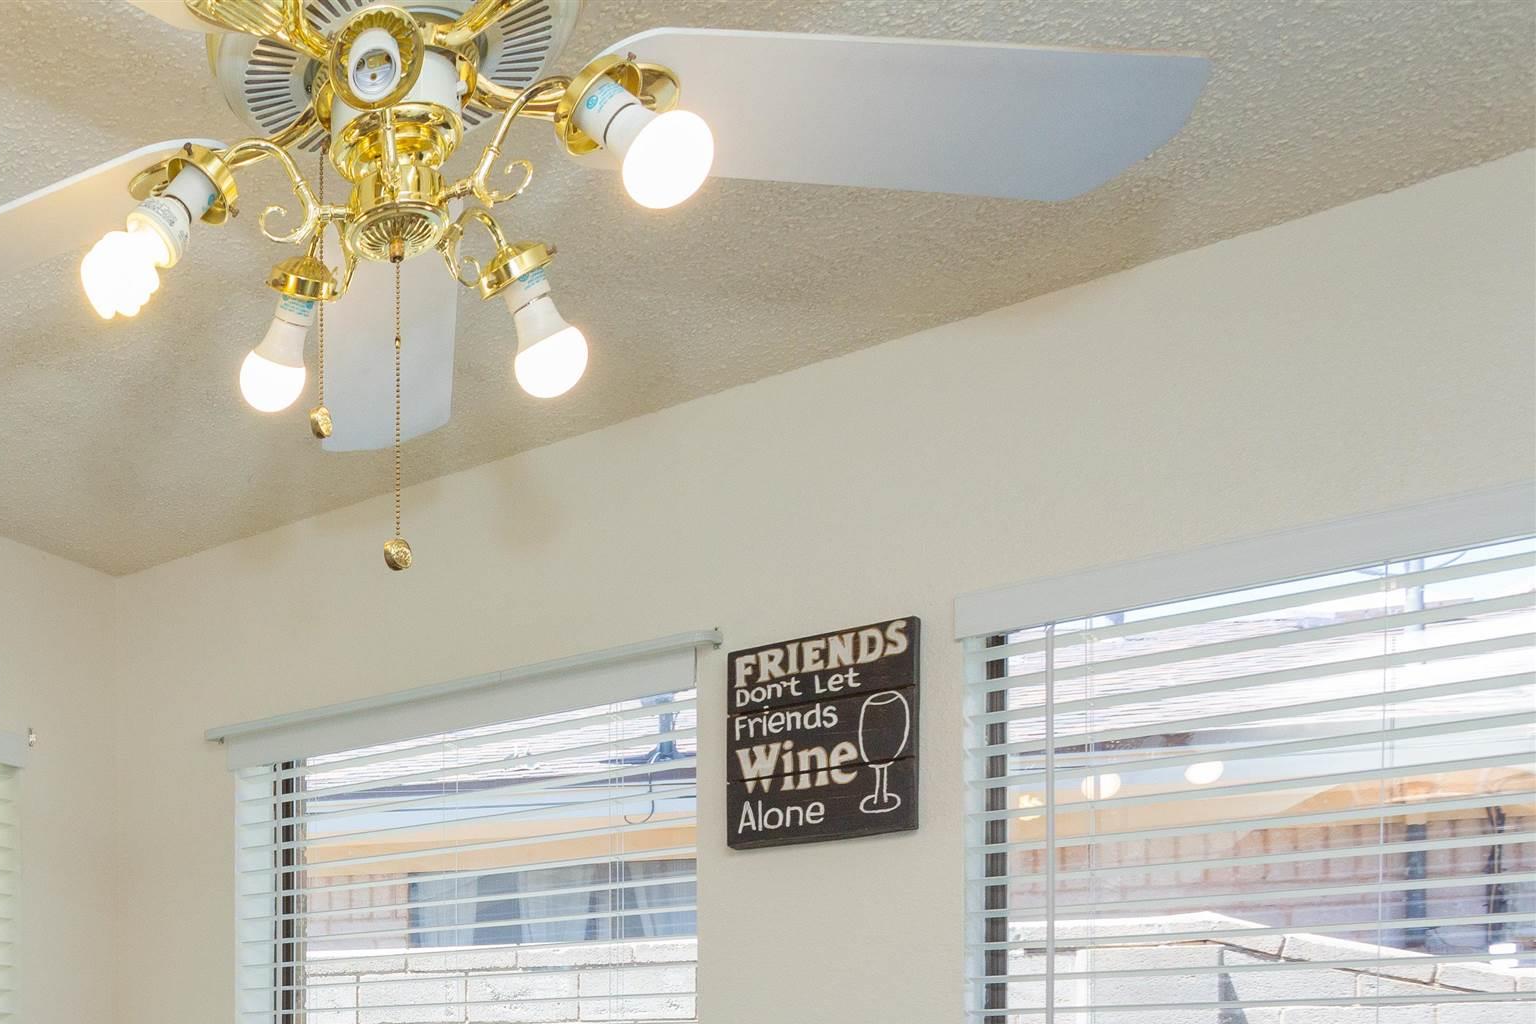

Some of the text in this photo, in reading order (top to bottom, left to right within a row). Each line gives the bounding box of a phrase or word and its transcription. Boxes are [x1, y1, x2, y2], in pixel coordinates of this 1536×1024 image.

[734, 620, 908, 688] FRIENDS
[815, 668, 862, 694] Let
[735, 702, 839, 741] Friends
[736, 740, 859, 794] Wine
[738, 800, 825, 834] Alone
